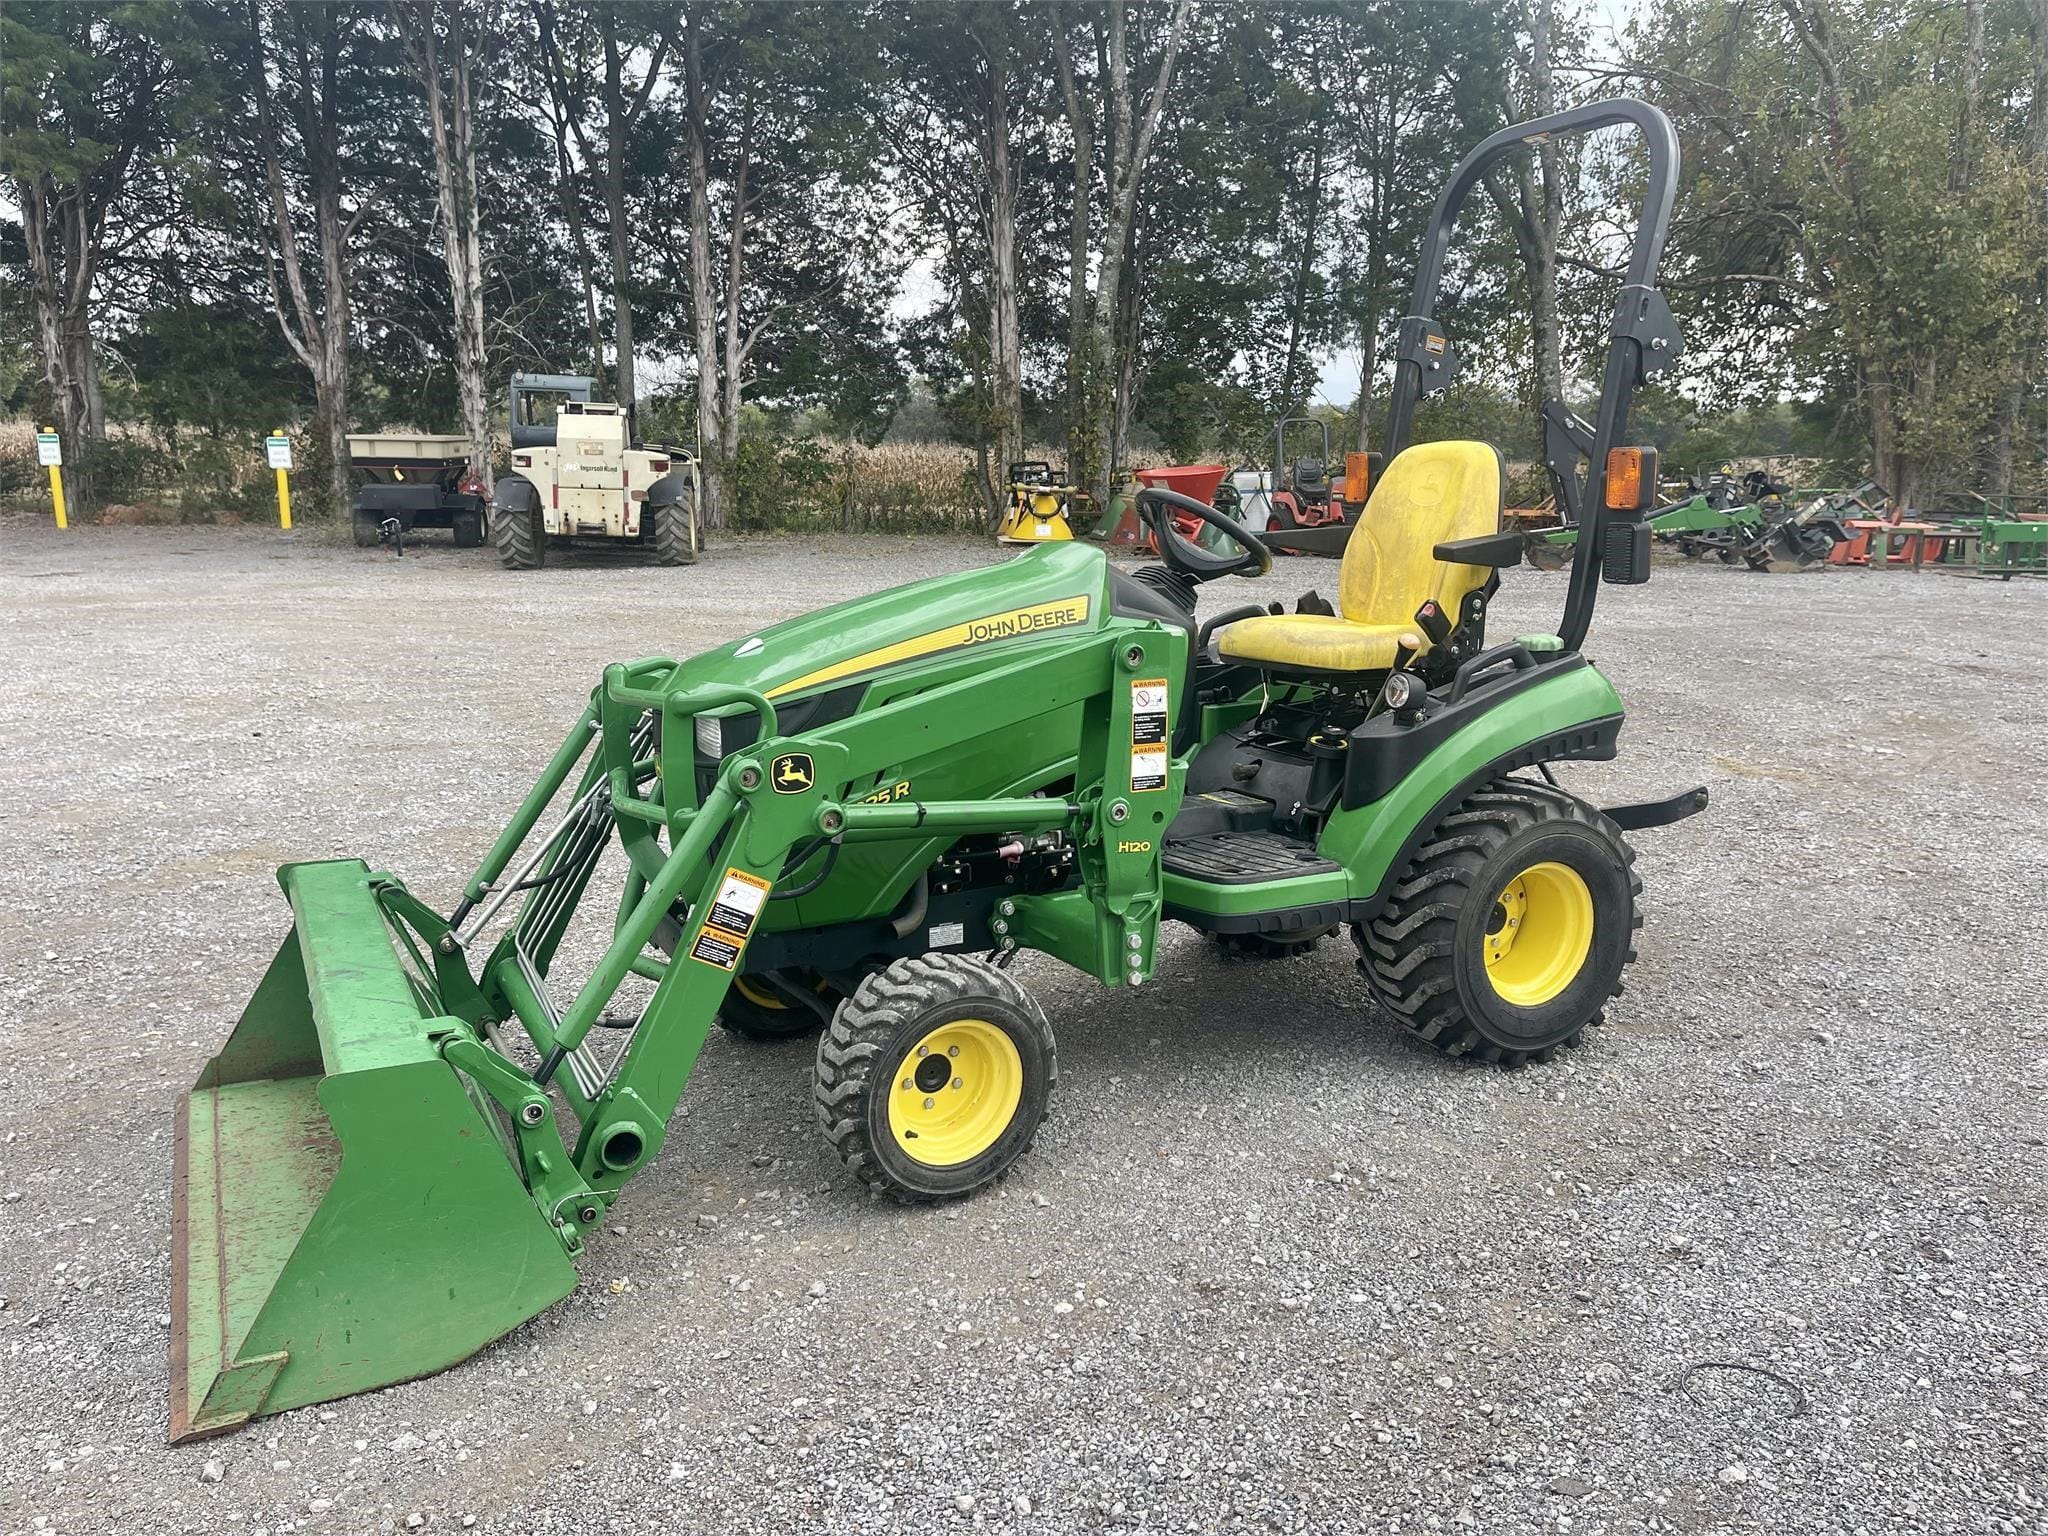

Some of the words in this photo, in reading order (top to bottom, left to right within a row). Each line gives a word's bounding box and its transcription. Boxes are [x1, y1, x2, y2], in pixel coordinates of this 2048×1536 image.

[580, 465, 603, 473] Ingersoll
[963, 619, 1015, 643] JOHN
[1018, 608, 1077, 631] DEERE
[1138, 680, 1166, 688] WARNING
[1138, 745, 1166, 753] WARNING
[895, 781, 910, 800] R
[1118, 841, 1151, 853] H120
[738, 874, 766, 888] WARNING
[712, 933, 740, 946] WARNING
